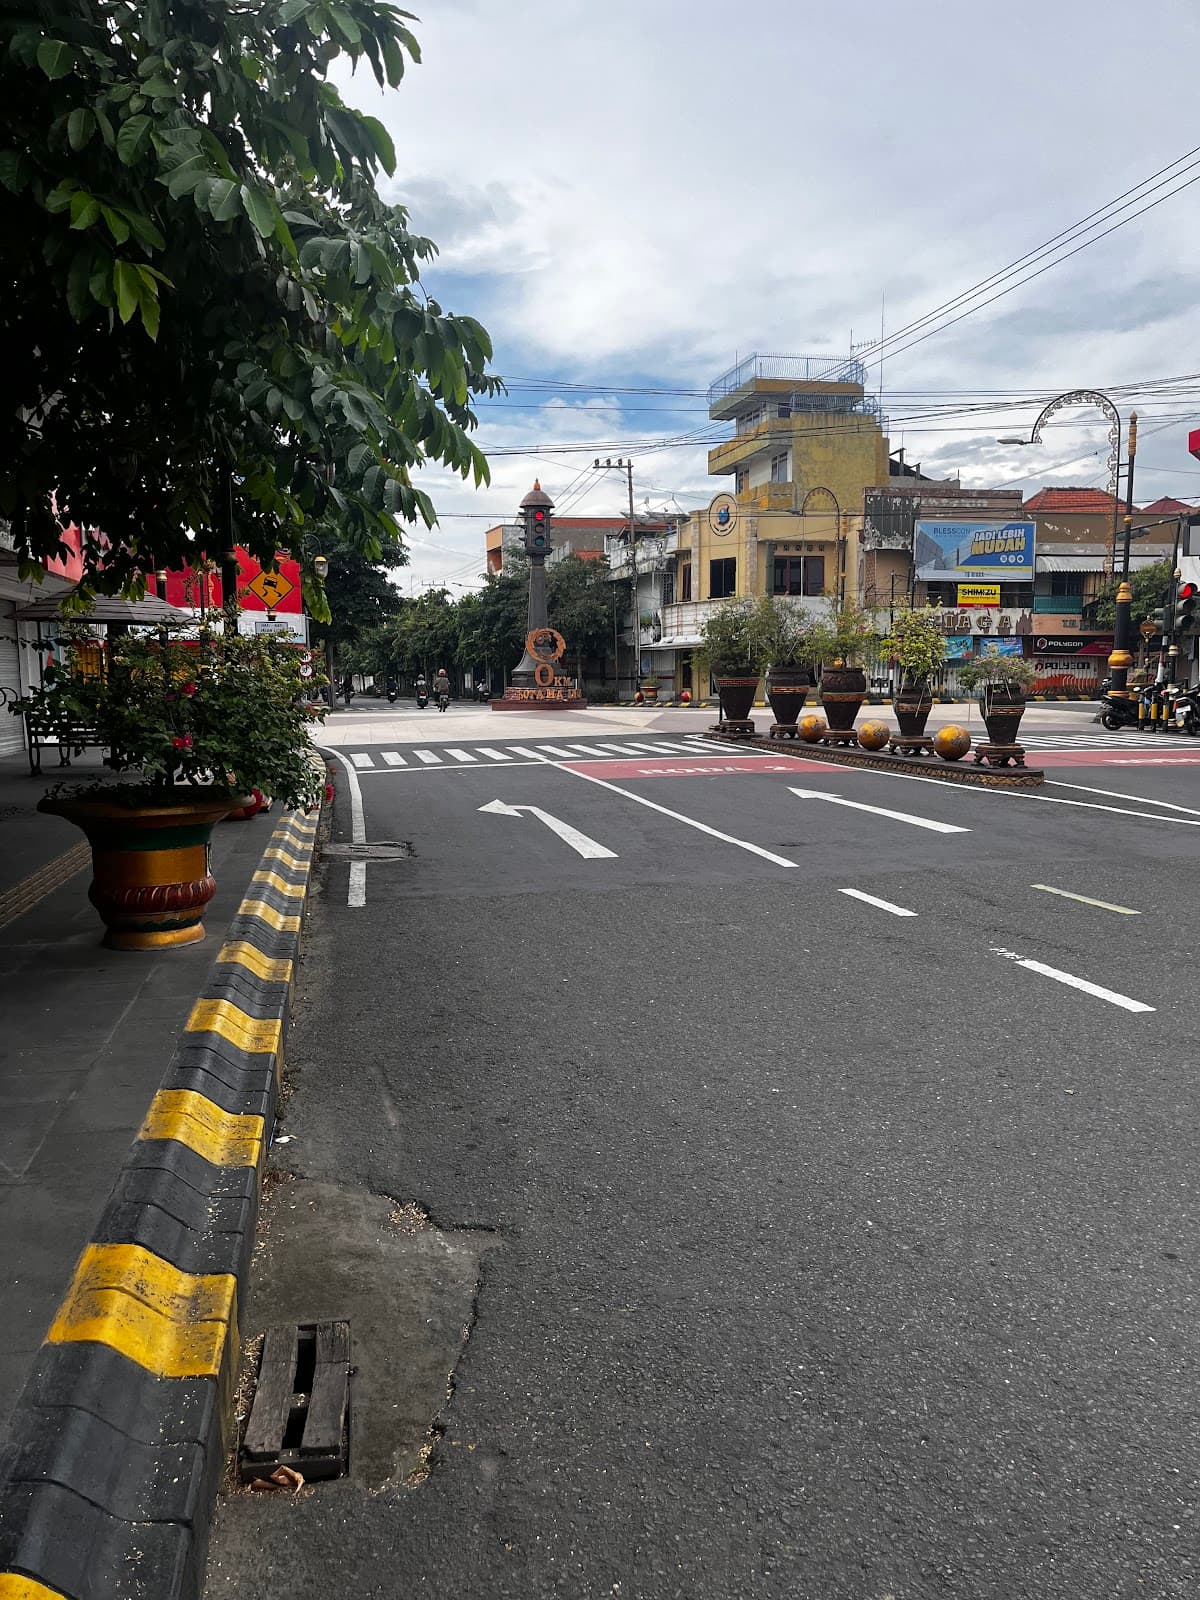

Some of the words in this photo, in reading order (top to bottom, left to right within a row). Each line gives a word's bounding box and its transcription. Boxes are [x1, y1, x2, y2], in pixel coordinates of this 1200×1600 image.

[975, 530, 997, 541] JADI
[997, 528, 1025, 539] LEBIH
[971, 537, 1026, 556] MUDAH
[962, 588, 997, 596] SHIMIZU
